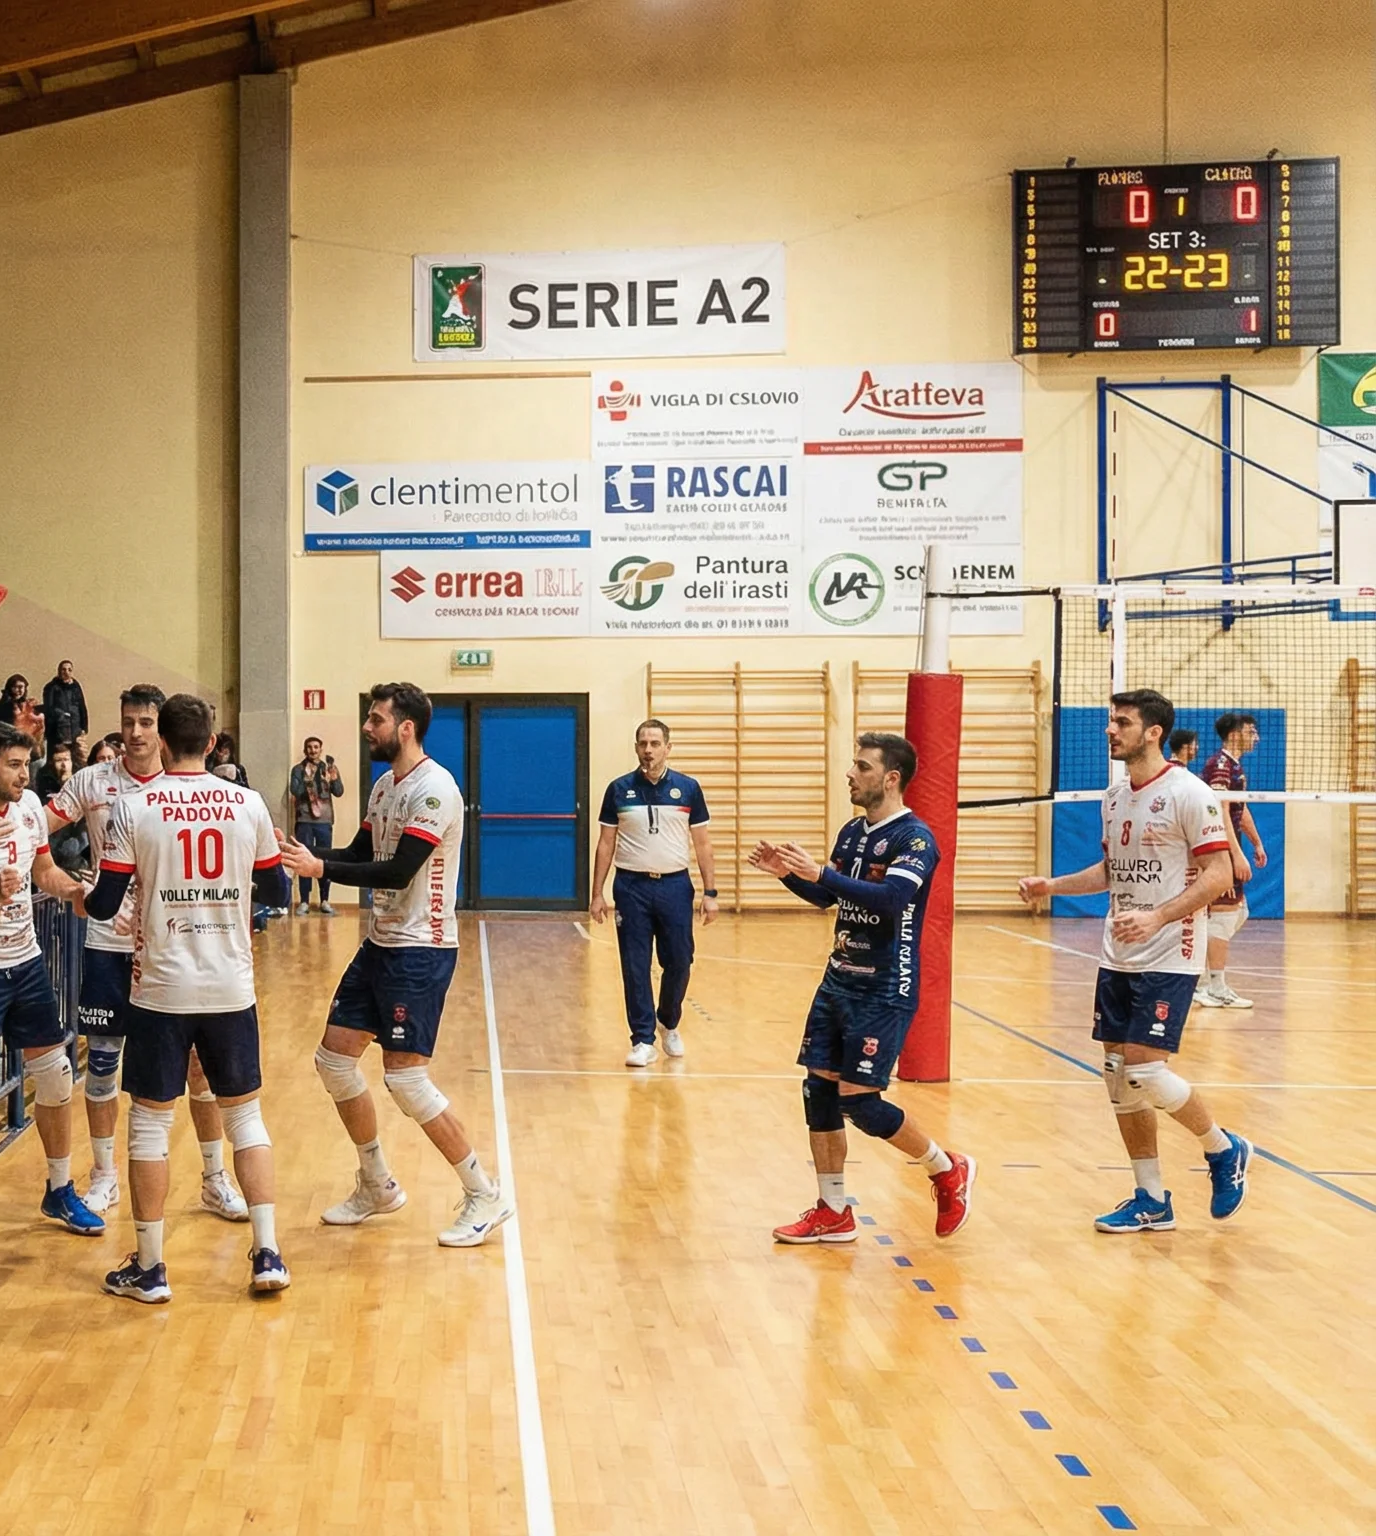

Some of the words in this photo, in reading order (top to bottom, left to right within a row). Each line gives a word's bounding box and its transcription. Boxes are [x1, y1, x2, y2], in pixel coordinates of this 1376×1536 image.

[1129, 190, 1149, 223] 0
[1236, 186, 1256, 219] 0
[1148, 232, 1182, 249] SET
[1188, 231, 1206, 248] 3:
[1124, 253, 1228, 290] 22-23
[507, 280, 678, 330] SERIE
[696, 277, 771, 324] A2
[650, 394, 700, 407] VIGLA
[706, 393, 723, 406] DI
[729, 391, 799, 406] CSLOVIO
[370, 474, 578, 506] clentimentol
[667, 465, 787, 498] RASCAI
[696, 556, 788, 575] Pantura
[435, 571, 523, 598] errea
[732, 580, 788, 599] irasti
[146, 790, 245, 806] PALLAVOLO
[162, 806, 235, 822] PADOVA
[1121, 820, 1132, 846] 8
[177, 828, 224, 879] 10
[160, 889, 200, 902] VOLLEY
